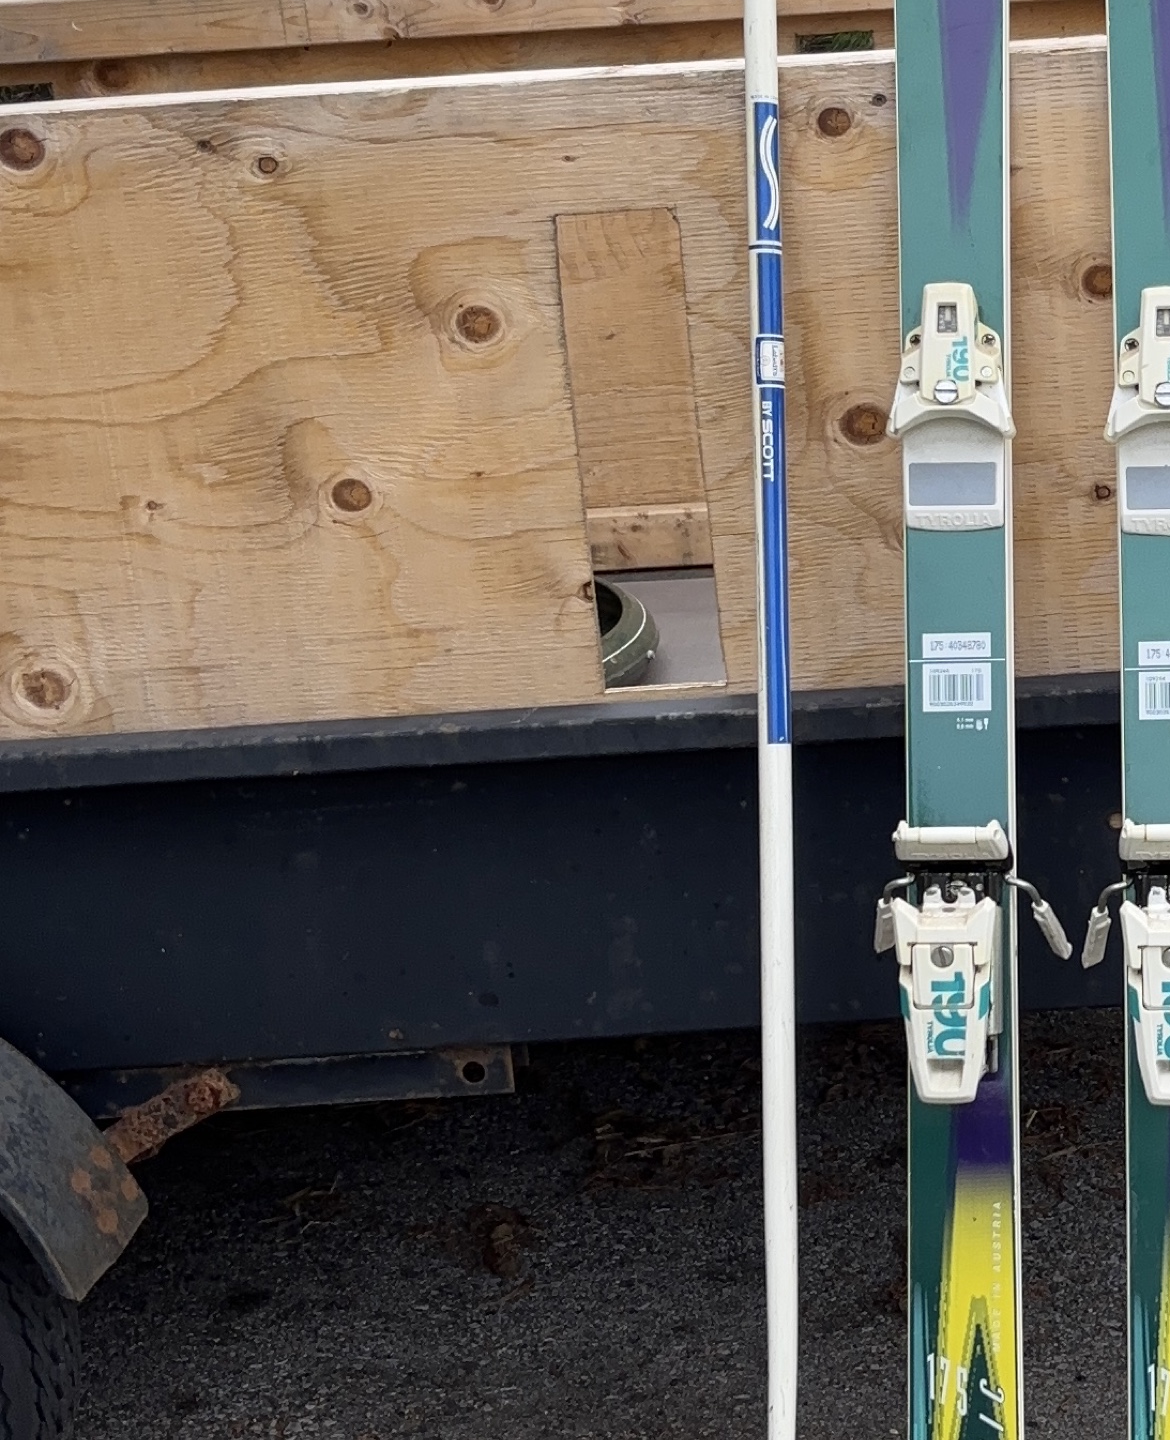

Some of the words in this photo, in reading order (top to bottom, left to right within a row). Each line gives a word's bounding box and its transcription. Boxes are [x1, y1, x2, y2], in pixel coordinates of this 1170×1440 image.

[952, 336, 969, 381] 190
[762, 401, 773, 417] BY
[762, 419, 775, 482] SCOTT
[914, 512, 993, 528] TYROLIA
[1146, 648, 1161, 659] 175
[931, 971, 967, 1056] 190
[993, 1201, 1002, 1272] AUSTRIA
[993, 1282, 1001, 1298] IN
[992, 1308, 1001, 1352] MADE
[926, 1352, 968, 1416] 175
